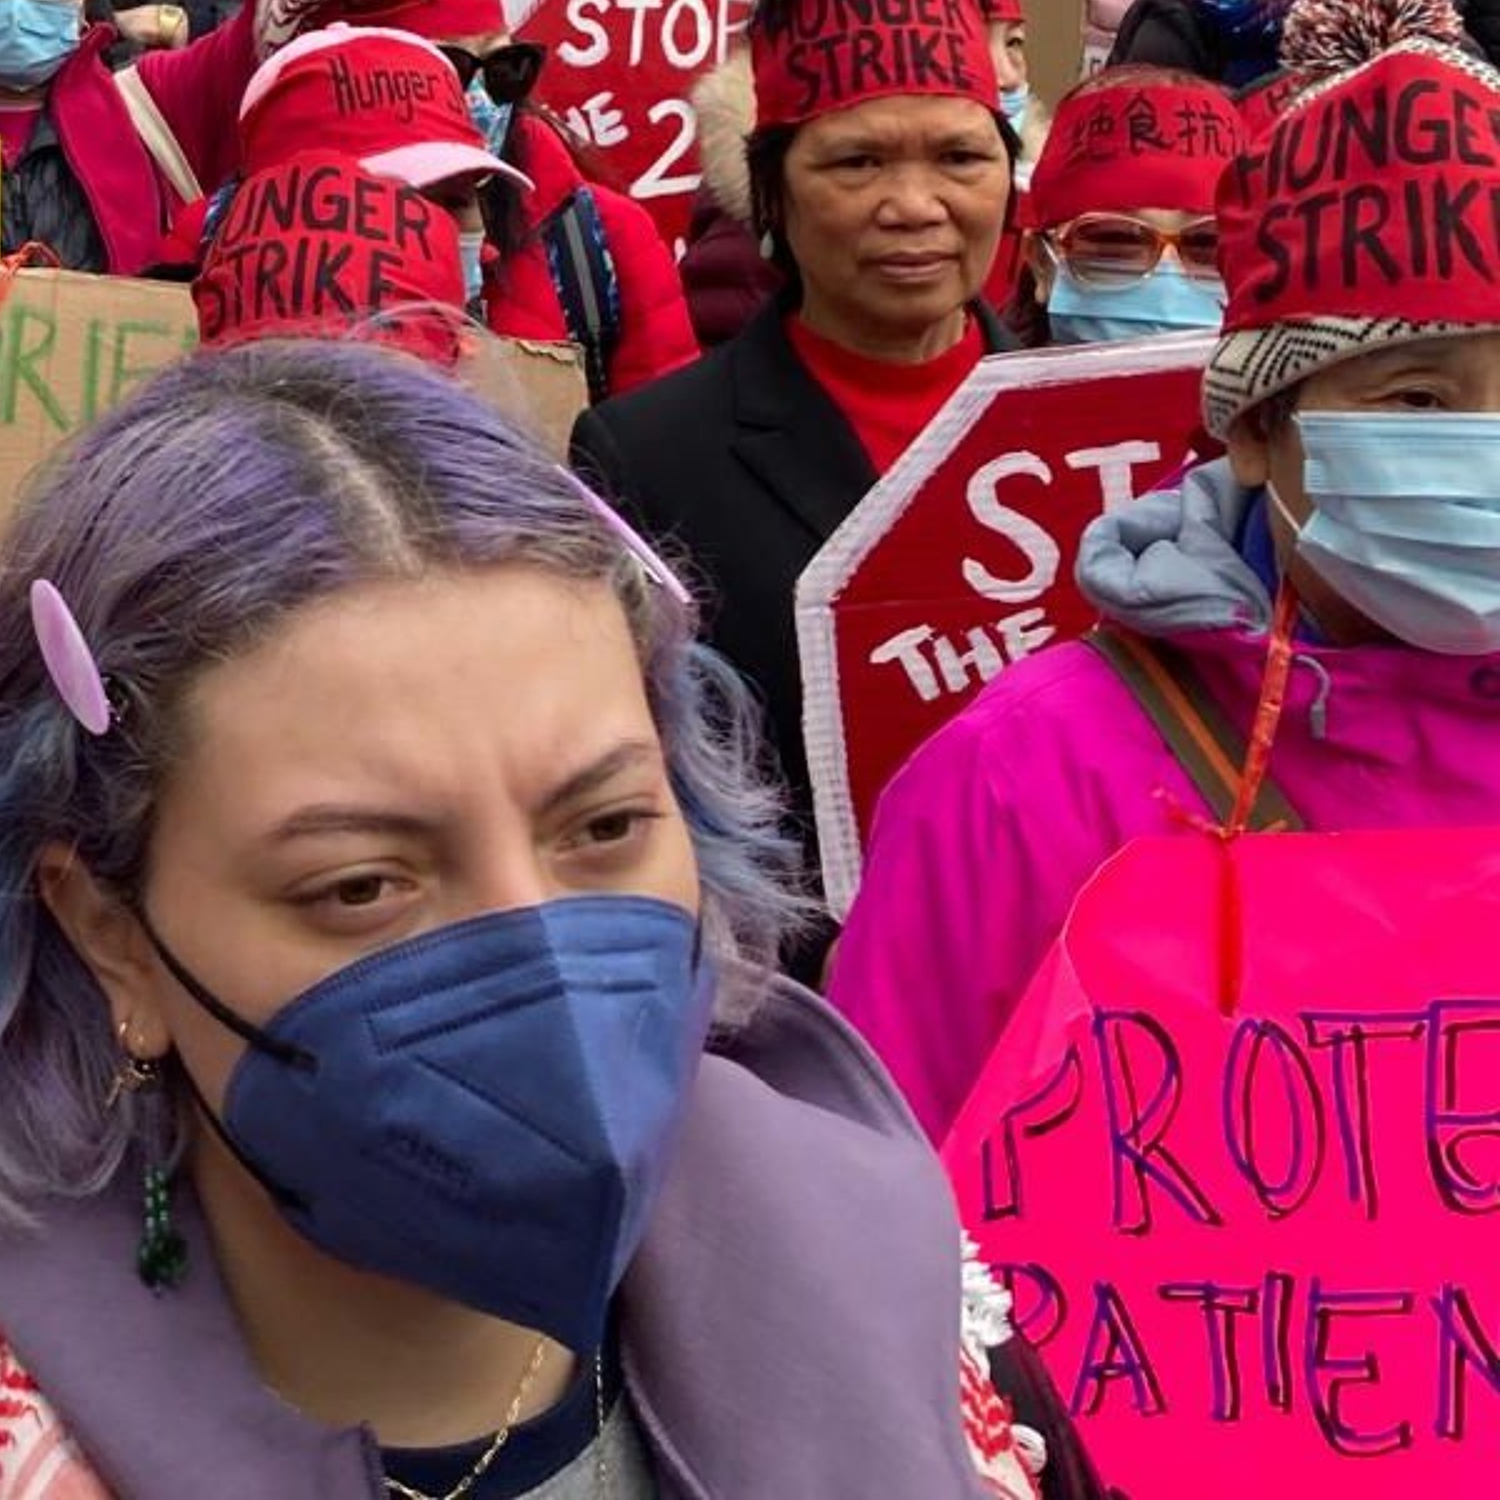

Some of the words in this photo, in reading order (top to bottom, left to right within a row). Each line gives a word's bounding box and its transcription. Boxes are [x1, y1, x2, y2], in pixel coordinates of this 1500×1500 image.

[329, 53, 439, 124] Hunger
[784, 29, 972, 116] STRIKE
[1235, 78, 1500, 210] HUNGE
[220, 164, 433, 262] UNGER
[1253, 177, 1500, 305] STRIK
[960, 440, 1162, 603] ST
